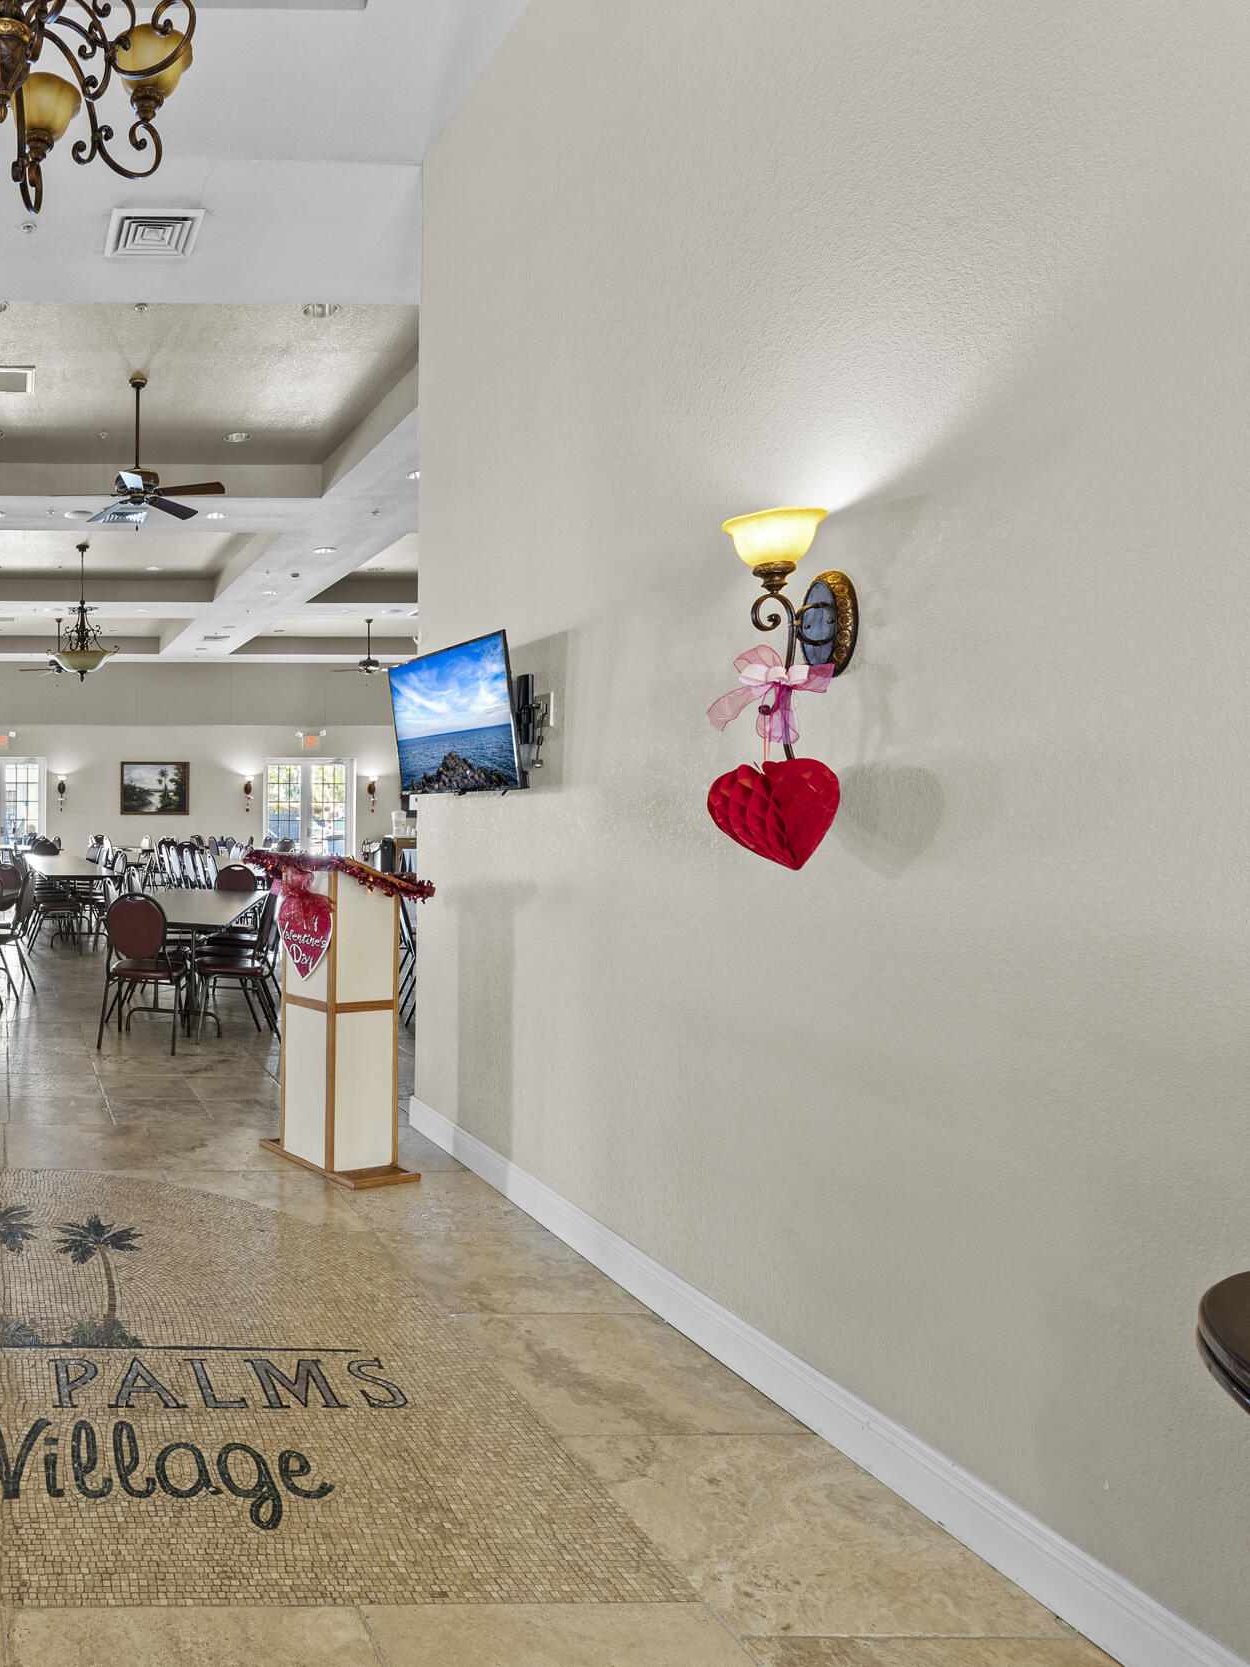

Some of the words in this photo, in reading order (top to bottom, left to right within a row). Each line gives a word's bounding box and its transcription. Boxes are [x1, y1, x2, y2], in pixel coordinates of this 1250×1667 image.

[282, 920, 328, 949] Valentine's
[289, 943, 315, 972] Day
[52, 1356, 408, 1409] PALMS
